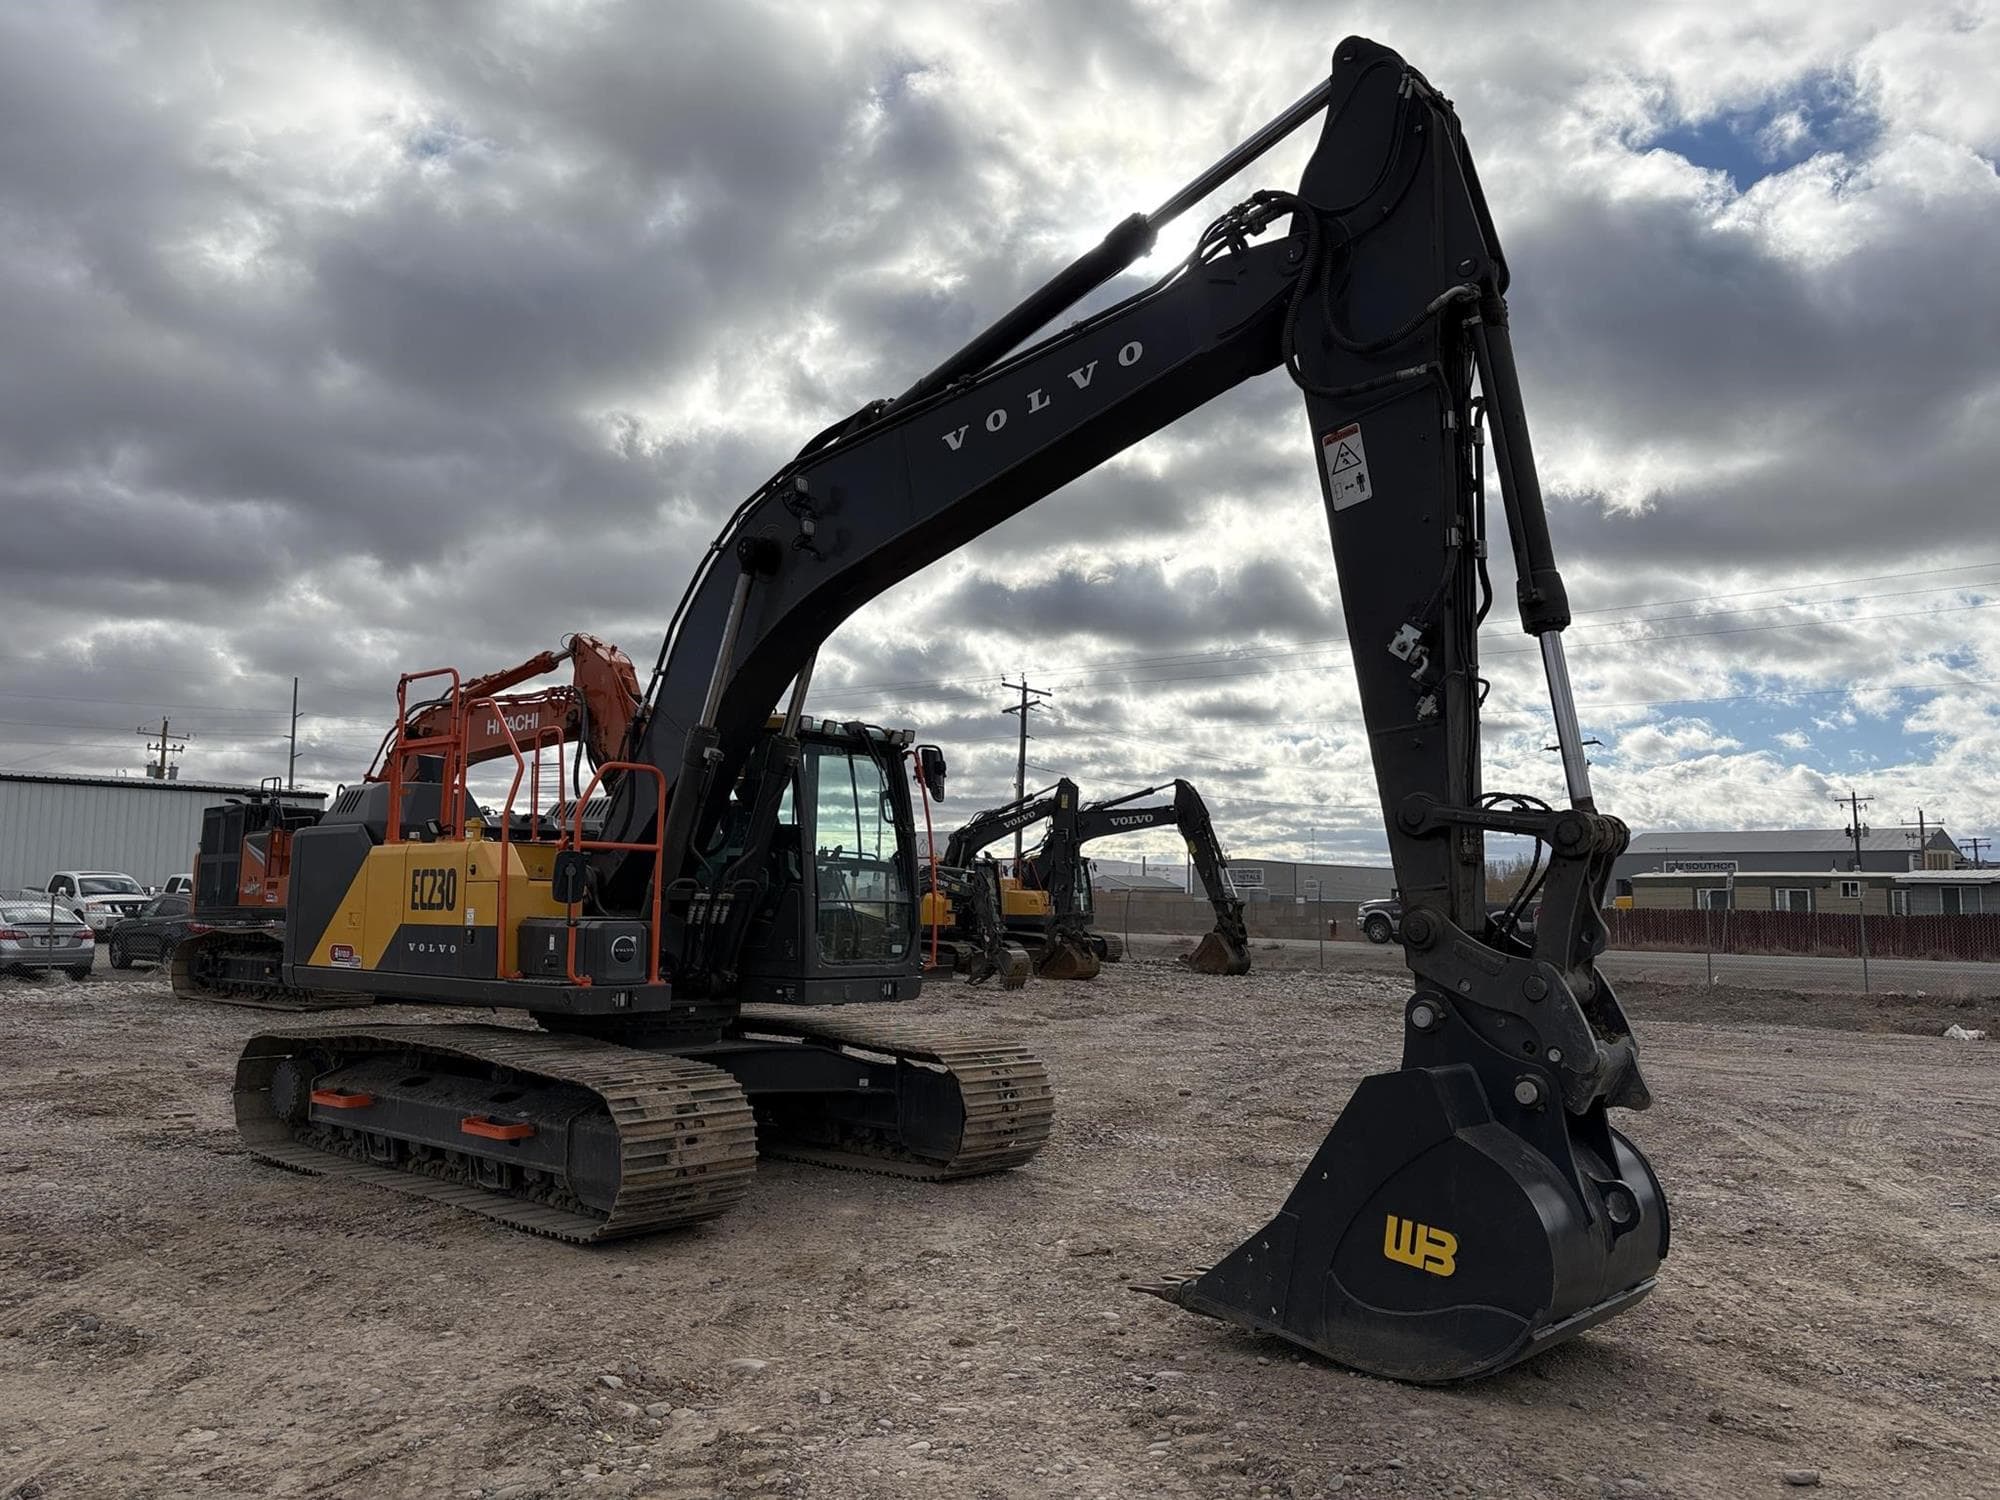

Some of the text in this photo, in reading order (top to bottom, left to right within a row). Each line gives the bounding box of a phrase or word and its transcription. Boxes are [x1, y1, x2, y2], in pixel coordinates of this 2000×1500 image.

[942, 341, 1143, 450] VOLVO
[1003, 811, 1036, 829] VOLVO
[1110, 814, 1154, 826] VOLVO
[411, 868, 457, 911] EC230
[408, 943, 457, 954] VOLVO
[1384, 1214, 1458, 1277] WB
